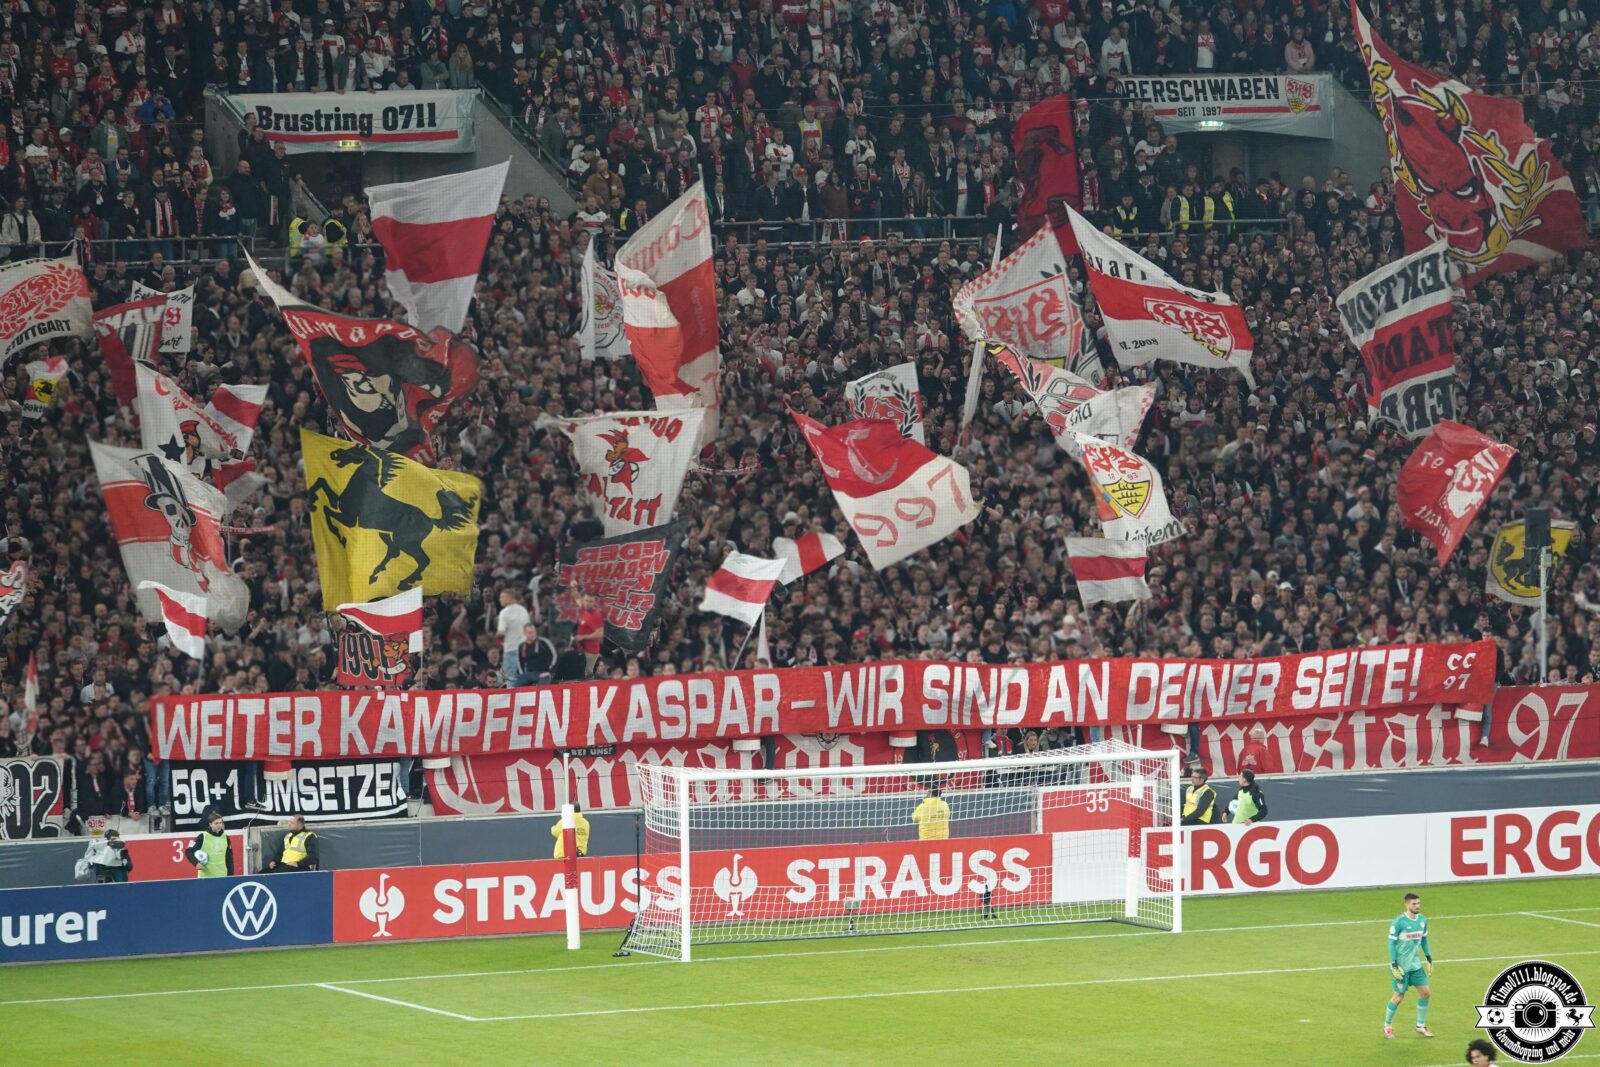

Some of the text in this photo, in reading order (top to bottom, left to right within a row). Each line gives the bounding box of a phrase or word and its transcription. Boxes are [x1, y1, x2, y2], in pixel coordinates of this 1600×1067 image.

[256, 102, 437, 138] Brustring 0711
[1177, 106, 1222, 117] SEIT 1997
[1132, 338, 1159, 349] 2008
[342, 633, 393, 682] 1997
[1442, 673, 1471, 690] 97
[1446, 652, 1477, 671] CC
[156, 696, 323, 761] WEITER
[339, 688, 571, 756] KÄMPFEN
[586, 673, 781, 746] KASPAR
[822, 663, 905, 728] WIR
[922, 663, 1030, 726] SIND
[1039, 660, 1111, 723] AN
[1125, 661, 1282, 721] DEINER
[1291, 647, 1424, 710] SEITE!
[1507, 691, 1589, 762] 97
[171, 768, 242, 815] 50+1
[1085, 790, 1109, 813] 35
[1145, 823, 1340, 893] ERGO
[1450, 809, 1600, 878] ERG
[432, 865, 683, 925] STRAUSS
[785, 847, 1032, 904] STRAUSS
